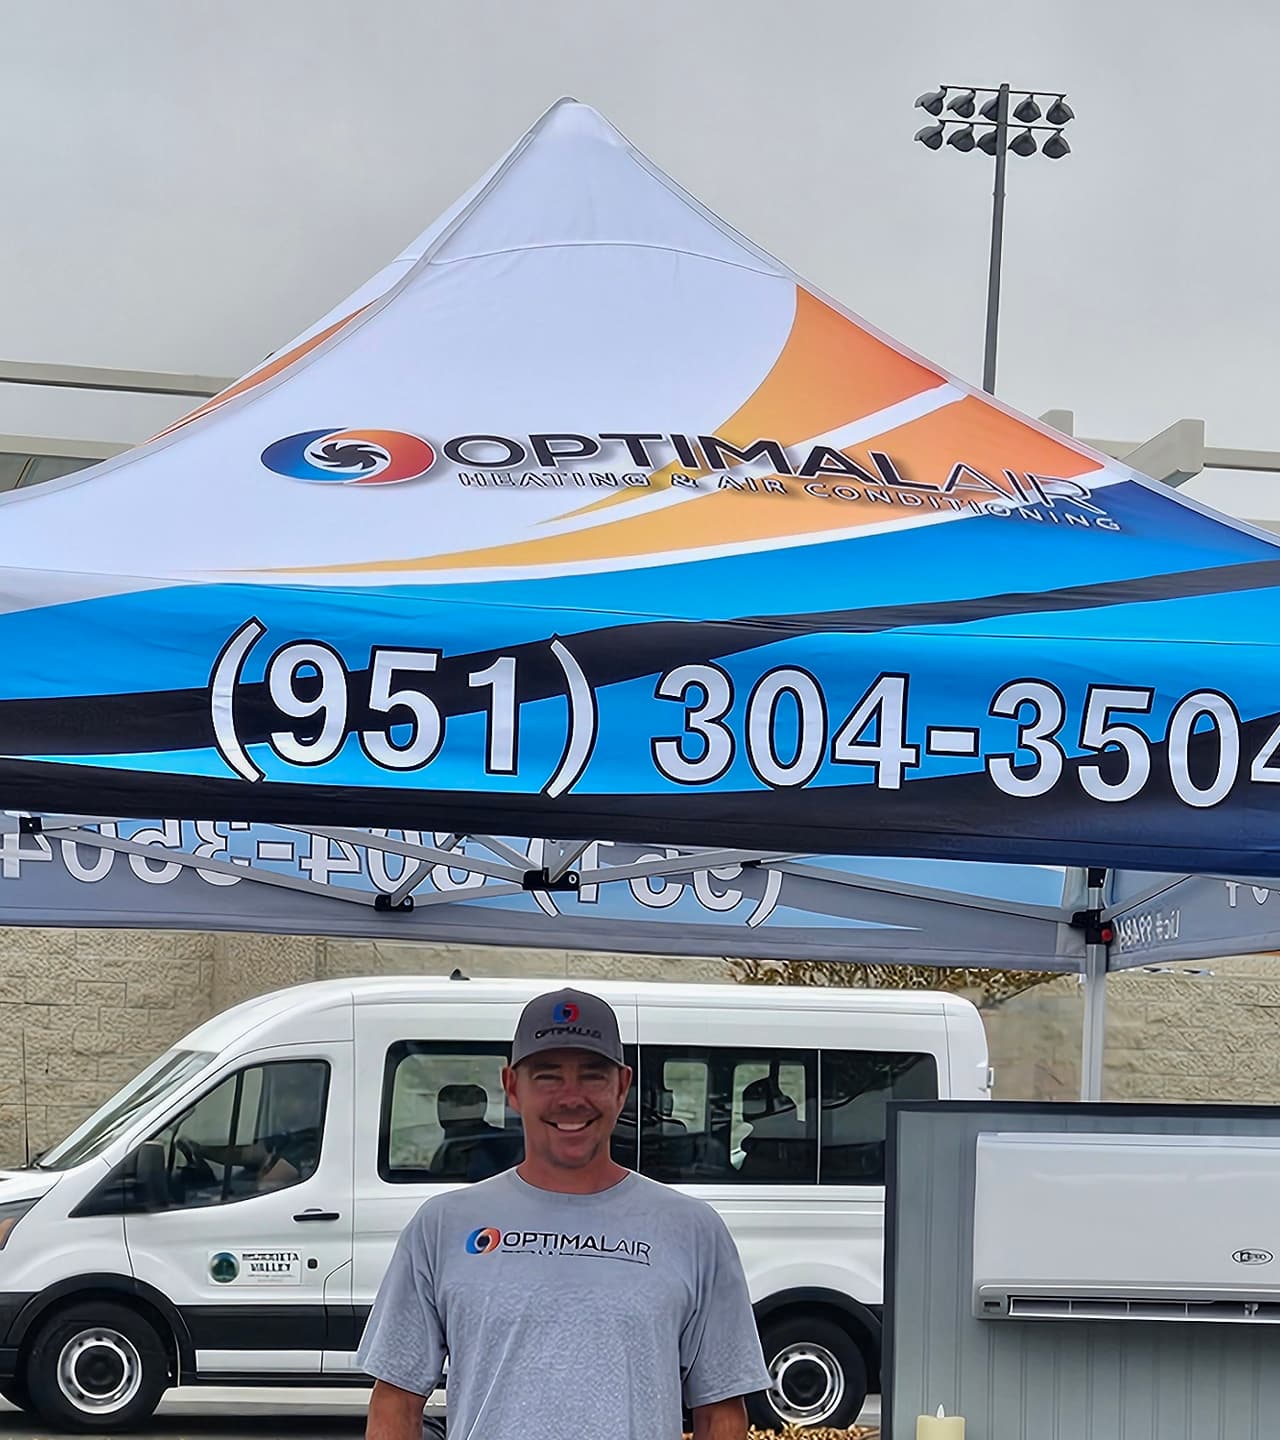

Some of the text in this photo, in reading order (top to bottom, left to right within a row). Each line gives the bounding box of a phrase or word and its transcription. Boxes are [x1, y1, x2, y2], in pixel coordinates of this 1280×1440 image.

[442, 431, 1108, 513] OPTIMALAIR
[457, 471, 1123, 532] HEATING & AIR CONDITIONING
[210, 618, 596, 799] (951)
[503, 1231, 652, 1259] OPTIMALAIR
